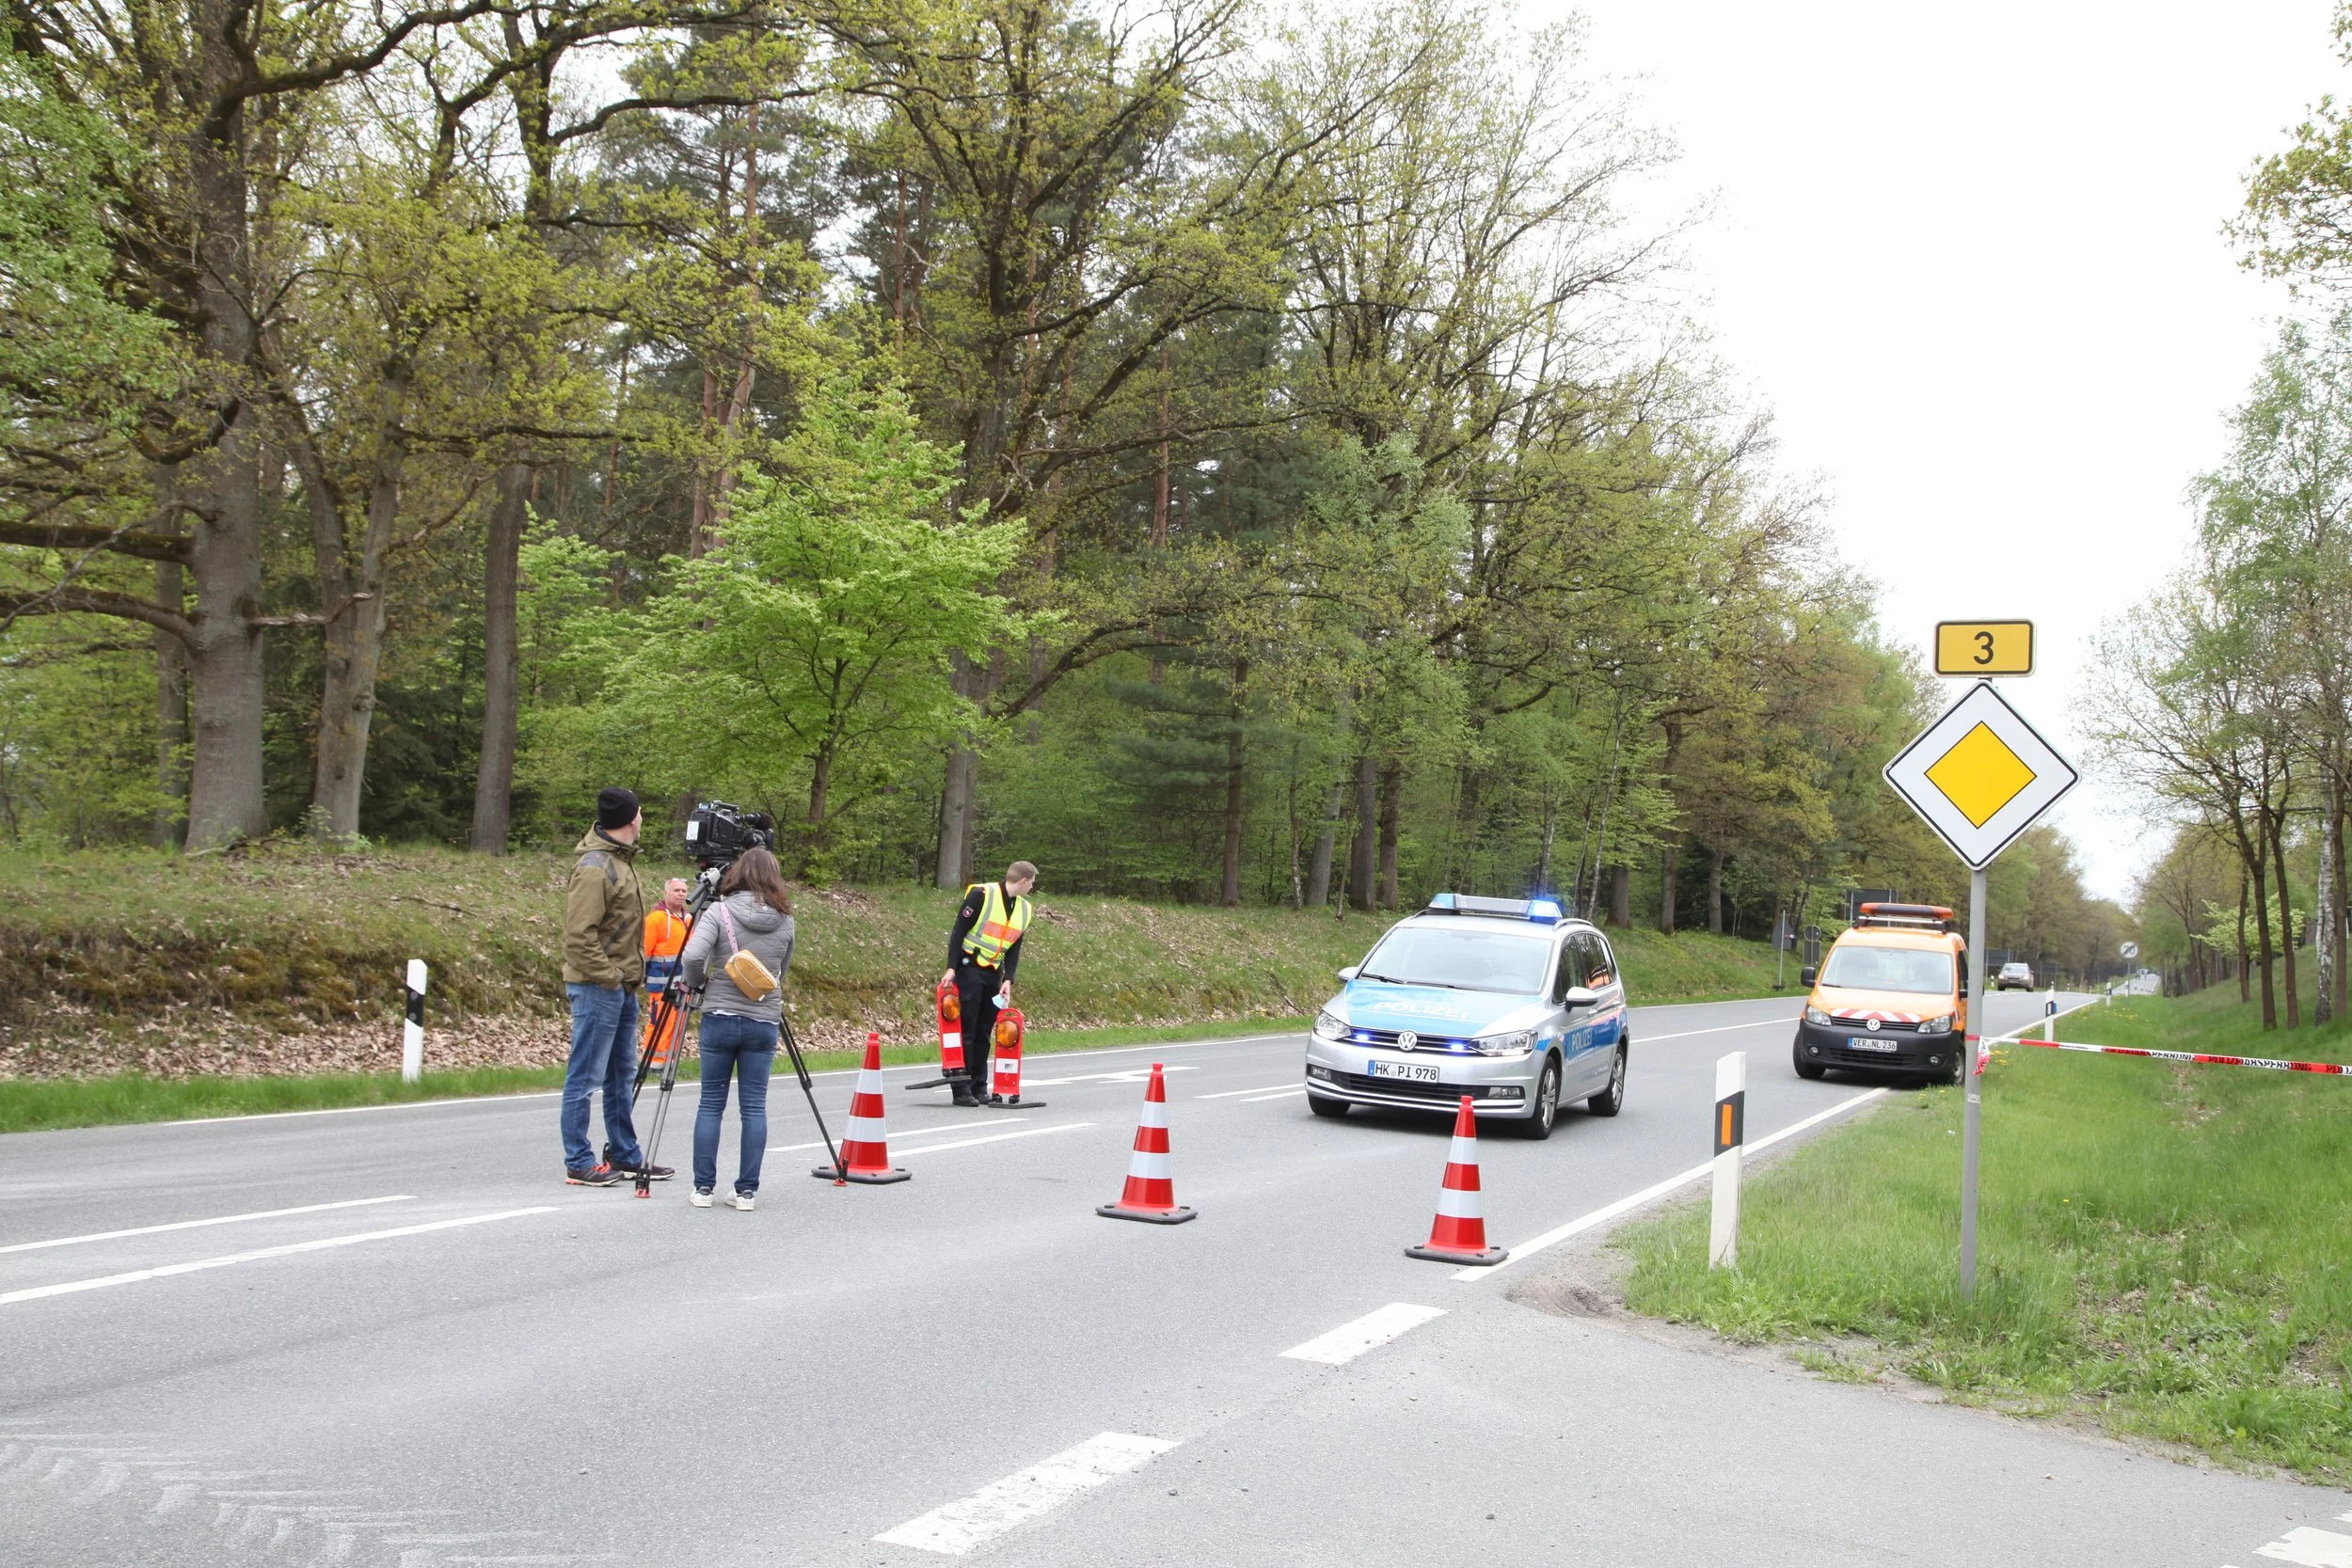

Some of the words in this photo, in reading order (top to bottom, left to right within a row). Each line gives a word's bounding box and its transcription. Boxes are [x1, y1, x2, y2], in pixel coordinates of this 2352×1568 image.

[1973, 630, 1994, 665] 3
[1374, 1002, 1469, 1019] POLIZEI
[1571, 1028, 1593, 1053] POLIZEI
[1852, 1038, 1867, 1047] VER
[1871, 1040, 1881, 1049] NL
[1882, 1040, 1897, 1050] 236
[1375, 1063, 1391, 1076] HK
[1397, 1065, 1411, 1078] PI
[1415, 1068, 1438, 1081] 978
